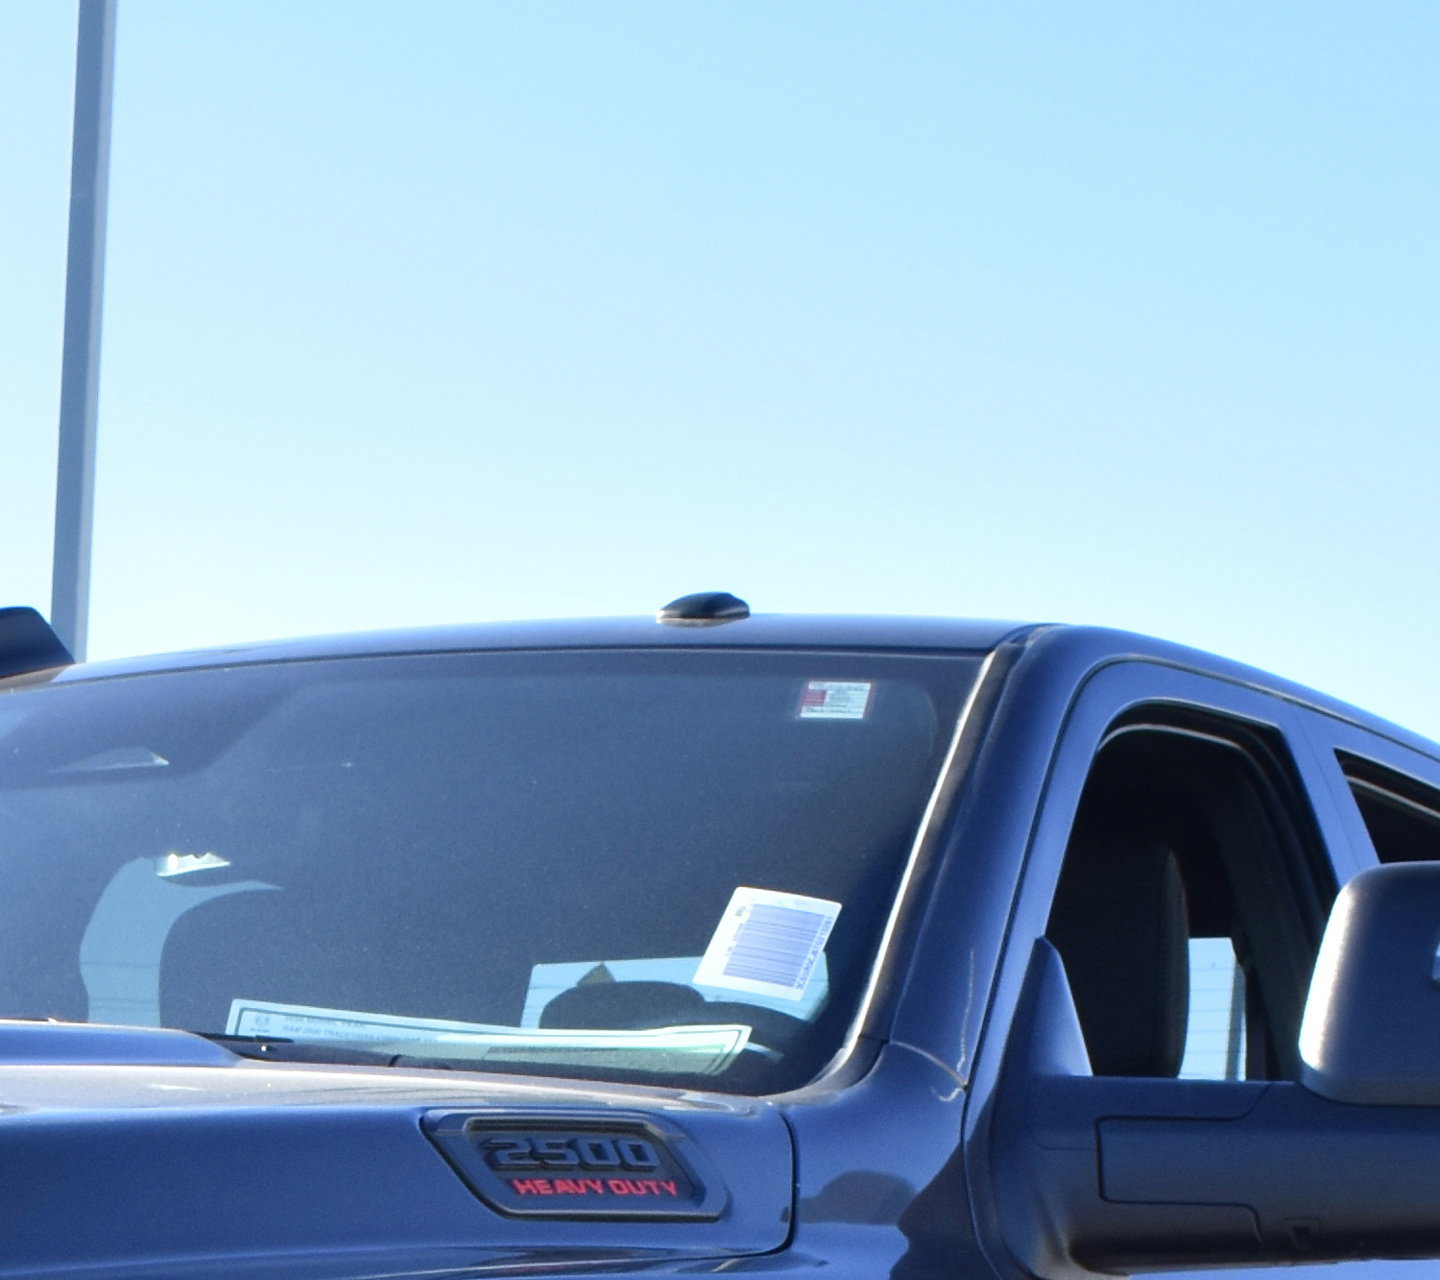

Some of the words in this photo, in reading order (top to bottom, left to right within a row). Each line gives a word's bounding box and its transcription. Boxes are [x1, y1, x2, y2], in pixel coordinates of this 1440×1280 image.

[481, 1137, 661, 1172] 2500
[512, 1178, 603, 1196] HEAVY
[609, 1179, 679, 1197] DUTY
